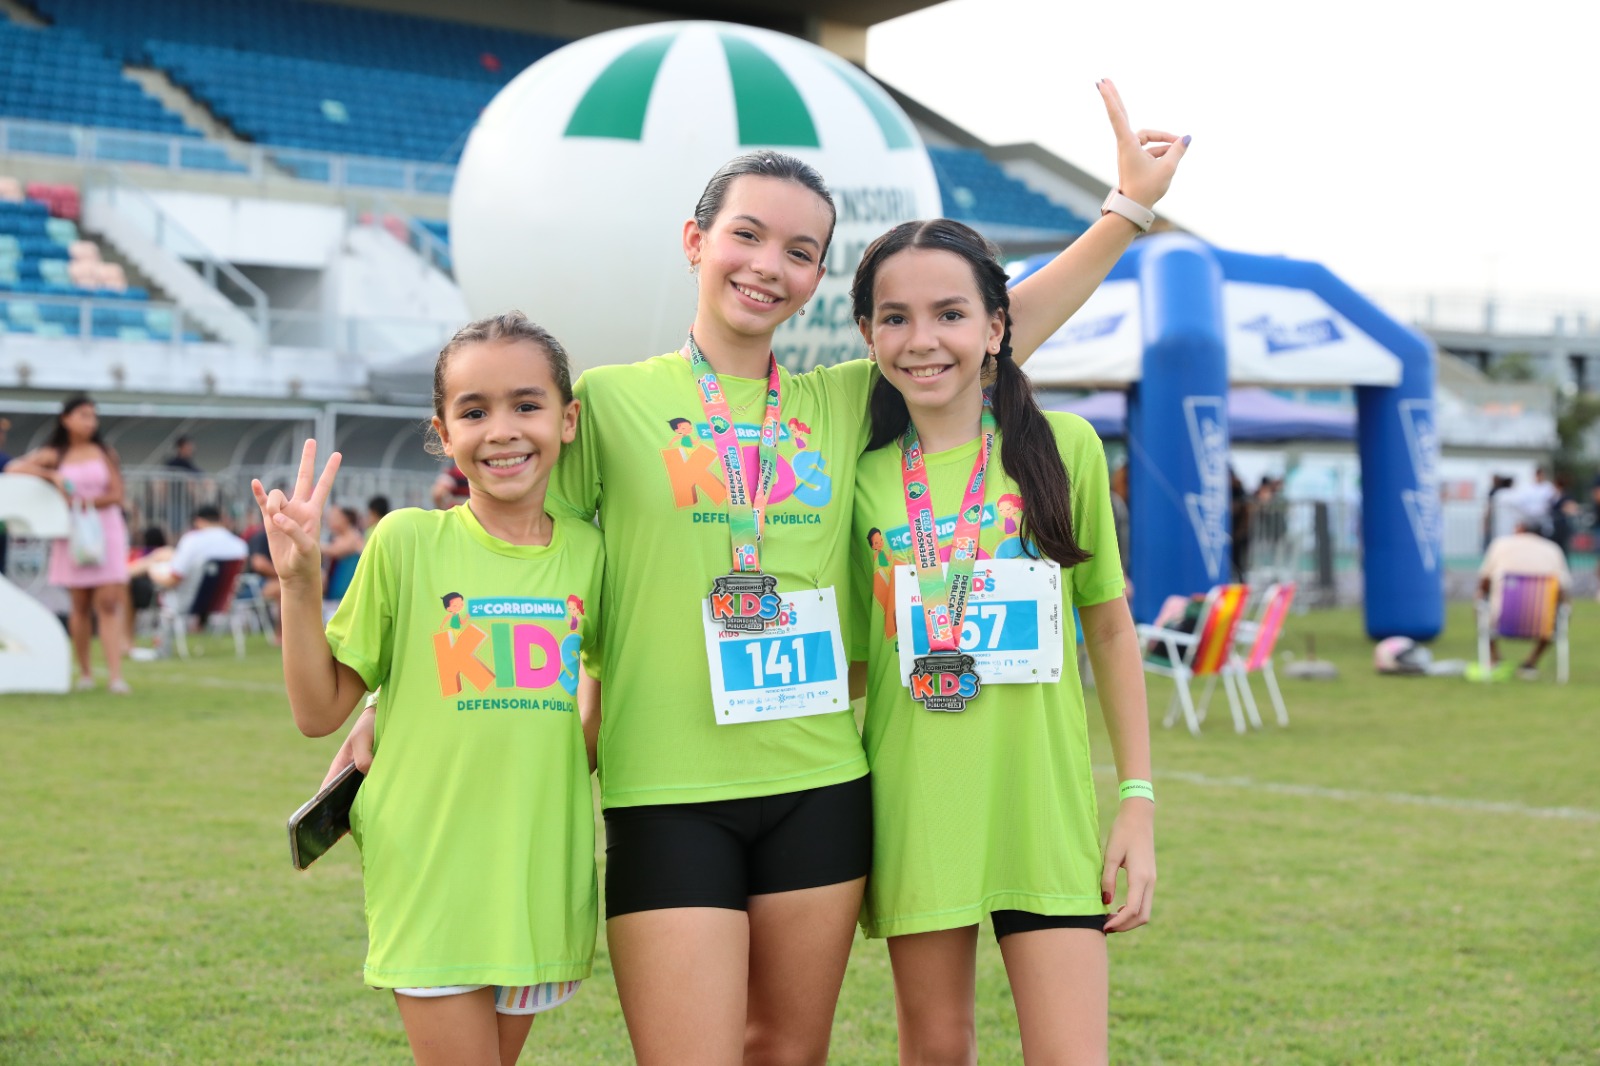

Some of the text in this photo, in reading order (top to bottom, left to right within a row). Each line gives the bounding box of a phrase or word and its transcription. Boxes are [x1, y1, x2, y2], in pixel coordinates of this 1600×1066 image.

[661, 444, 832, 508] KDS
[724, 454, 738, 505] DEFENSORIA
[734, 470, 746, 505] PÚBLICA
[773, 512, 821, 524] PÚBLICA
[921, 511, 937, 567] PÚBLICA 2025
[914, 517, 928, 568] DEFENSORIA
[484, 602, 564, 614] CORRIDINHA
[712, 593, 779, 619] KIDS
[949, 574, 960, 608] PÚBLICA
[953, 575, 969, 626] DEFENSORIA
[433, 623, 583, 697] KIDS
[746, 637, 806, 687] 141
[457, 698, 573, 712] DEFENSORIA PÚBLIC
[912, 672, 977, 698] KIDS
